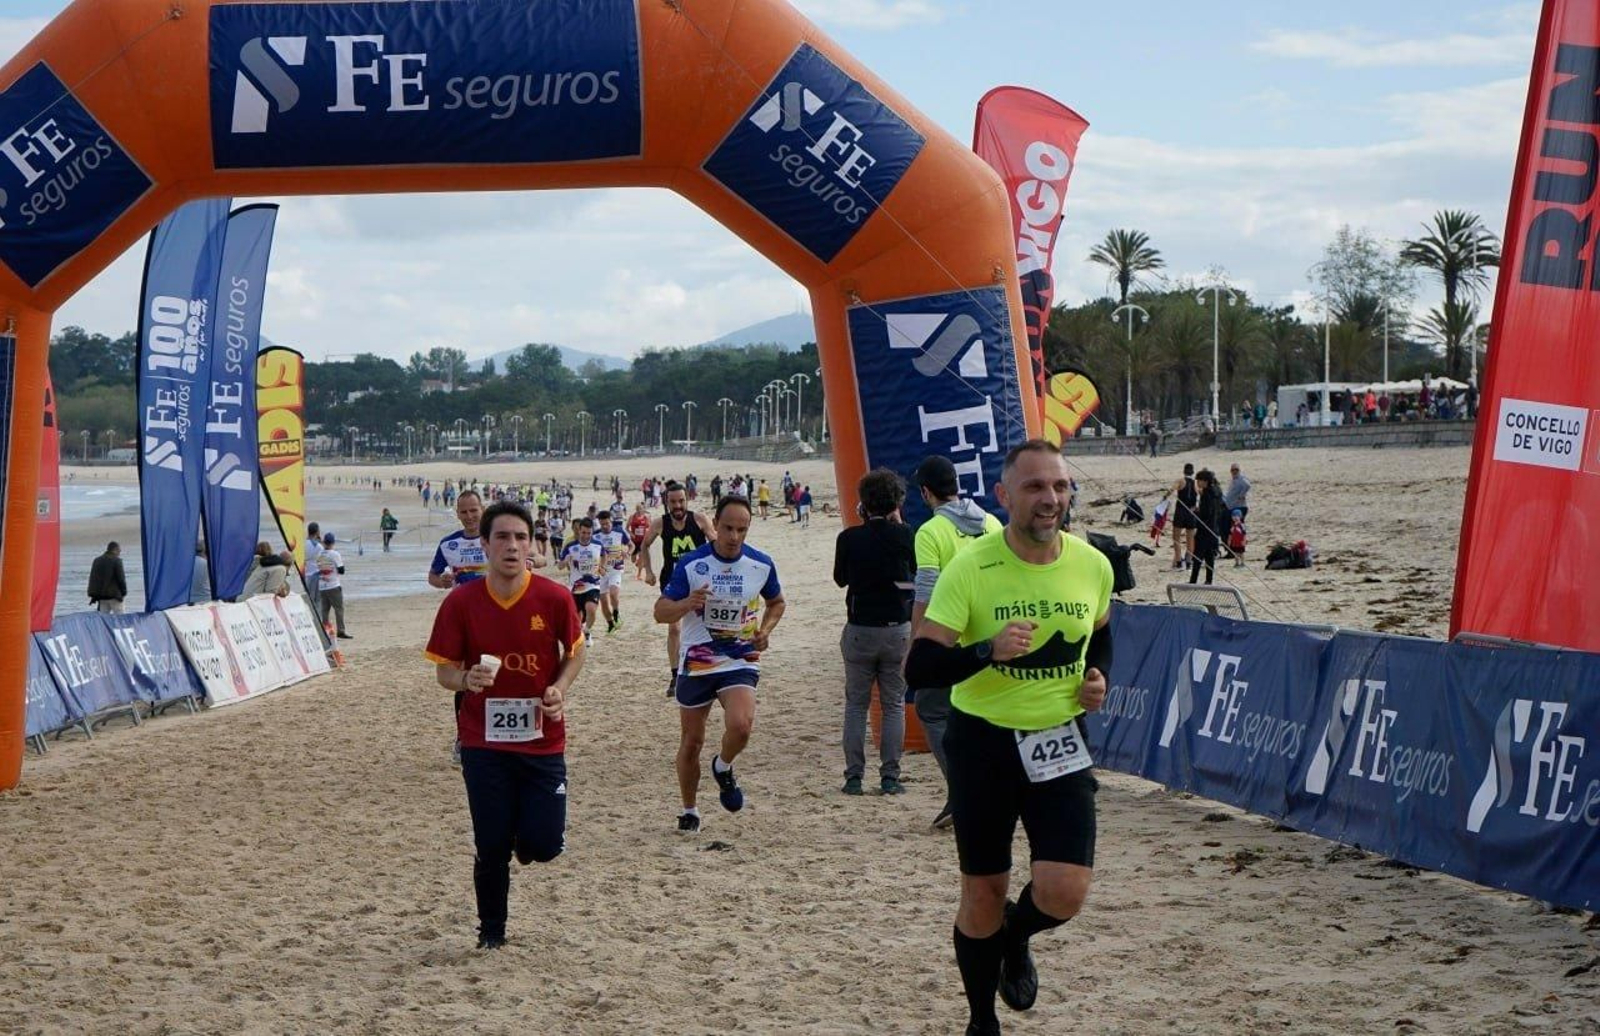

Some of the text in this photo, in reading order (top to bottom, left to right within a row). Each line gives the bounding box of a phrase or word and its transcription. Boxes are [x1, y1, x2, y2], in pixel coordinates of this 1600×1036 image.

[326, 35, 620, 120] FE seguros
[0, 118, 77, 188] FE
[19, 136, 112, 225] seguros
[770, 145, 867, 224] seguros
[805, 111, 877, 189] FE
[1520, 42, 1600, 291] RUN
[148, 295, 188, 371] 100
[206, 276, 250, 439] FE seguros
[145, 388, 178, 434] FE
[177, 384, 191, 442] seguros
[260, 440, 300, 455] GADIS
[1506, 412, 1580, 437] CONCELLO
[1513, 433, 1572, 455] DE VIGO
[710, 608, 739, 621] 387
[995, 600, 1037, 620] máis
[1054, 602, 1090, 620] auga
[493, 712, 529, 728] 281
[1198, 653, 1307, 762] FE seguros
[1348, 680, 1454, 803] FE seguros
[1031, 734, 1079, 763] 425
[1519, 701, 1586, 822] FE
